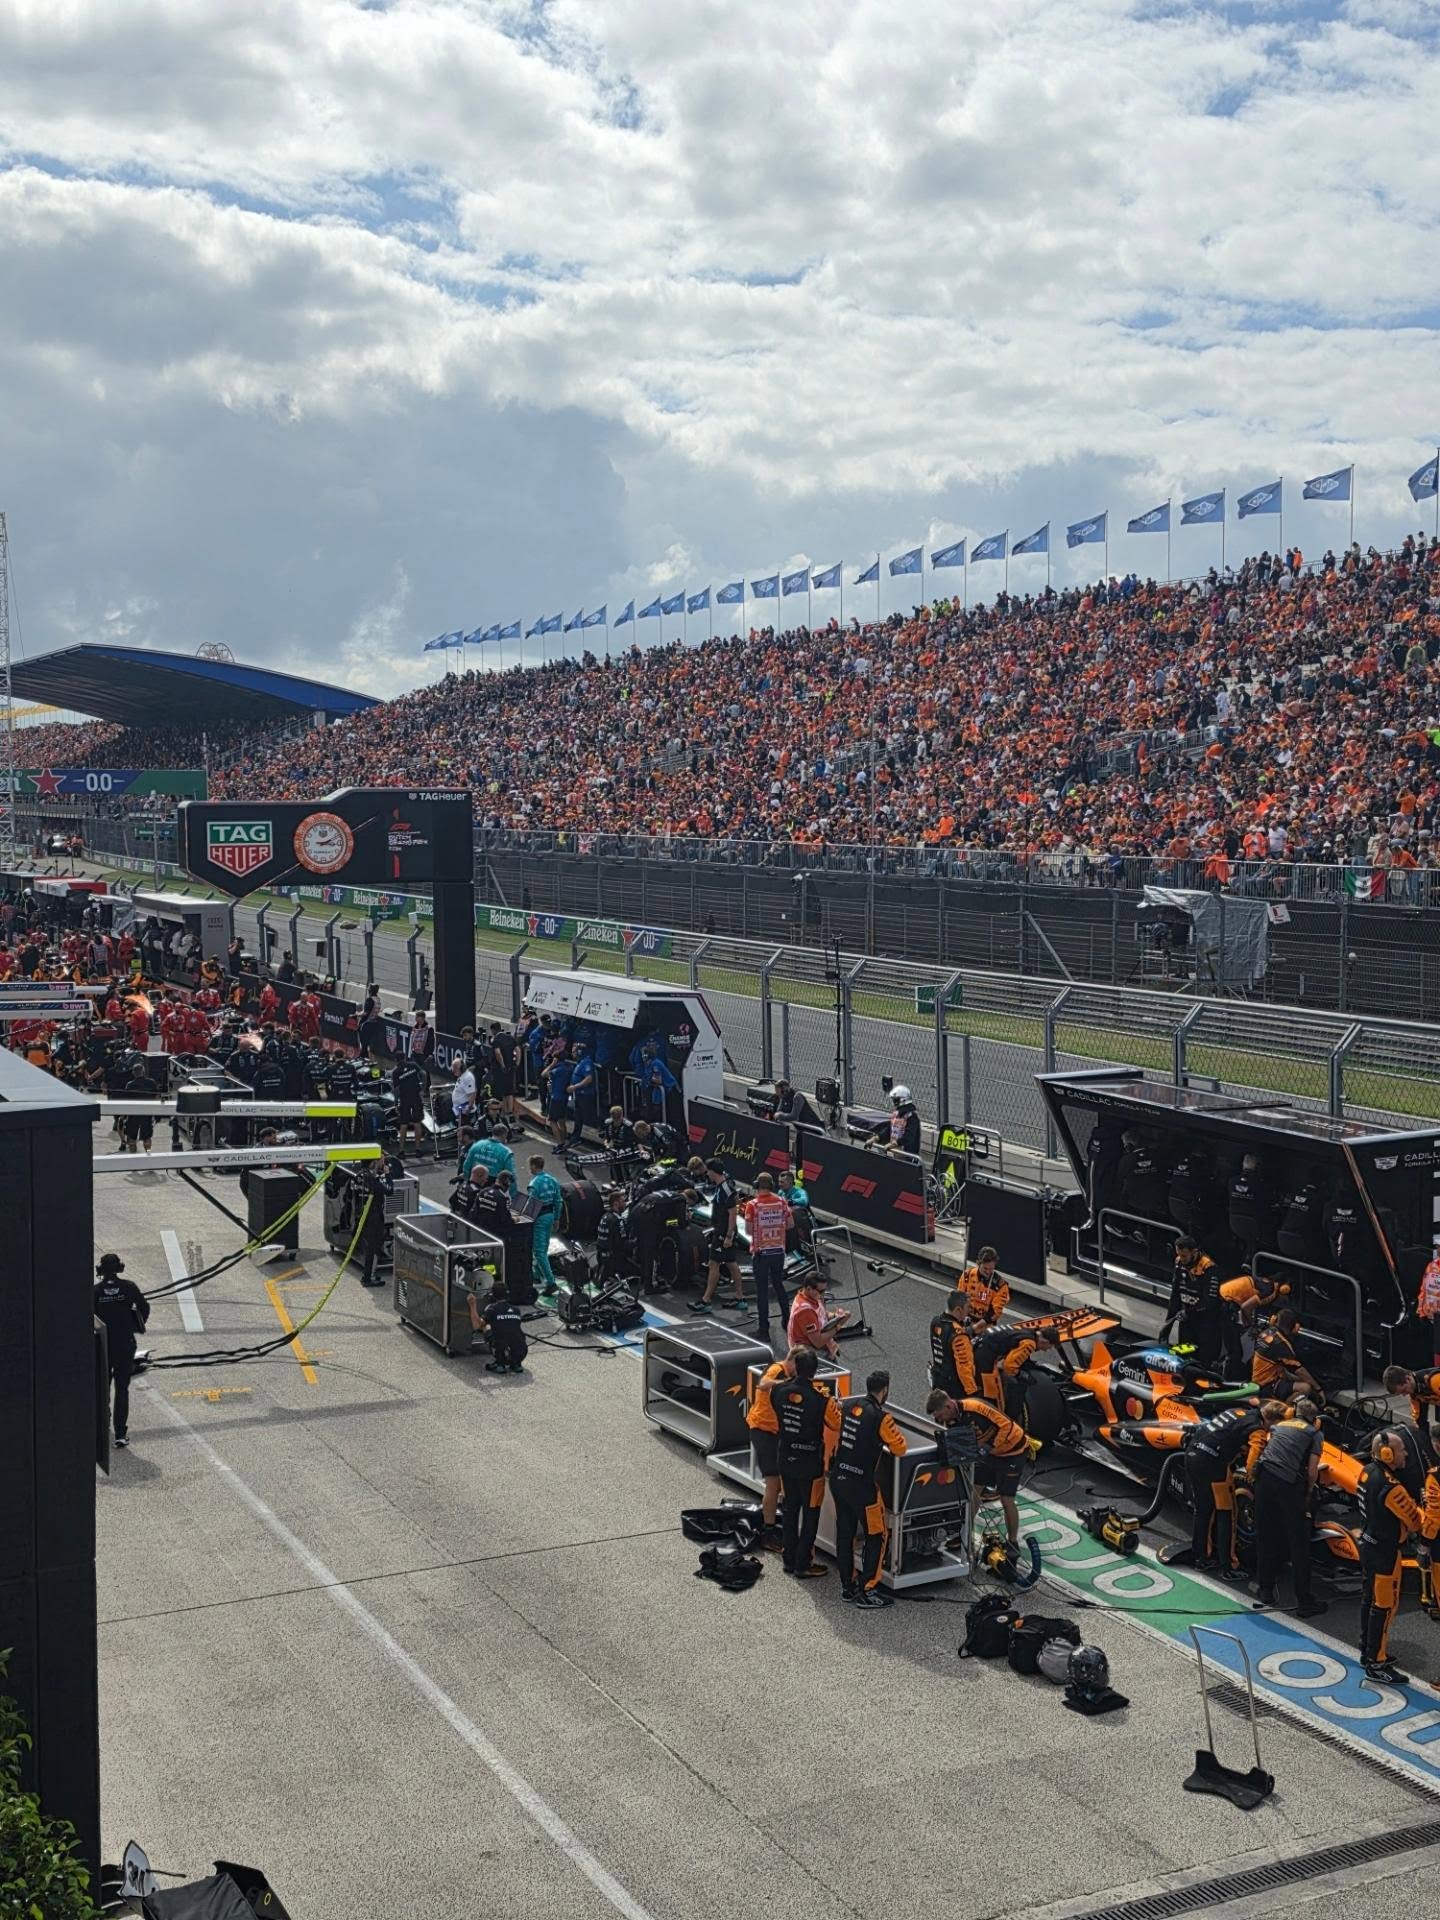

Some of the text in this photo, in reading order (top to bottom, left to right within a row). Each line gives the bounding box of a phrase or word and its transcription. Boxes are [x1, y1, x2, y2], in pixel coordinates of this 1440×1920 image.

[212, 825, 267, 842] TAG
[212, 846, 269, 872] HEUER
[415, 898, 434, 915] Heine
[489, 909, 525, 930] Heineken
[1067, 1090, 1112, 1106] CADILLAC
[714, 1130, 759, 1165] Zandvoort
[947, 1136, 965, 1149] BOT
[1404, 1152, 1440, 1161] CADILL
[454, 1264, 466, 1286] 12
[1118, 1360, 1146, 1385] Gemini
